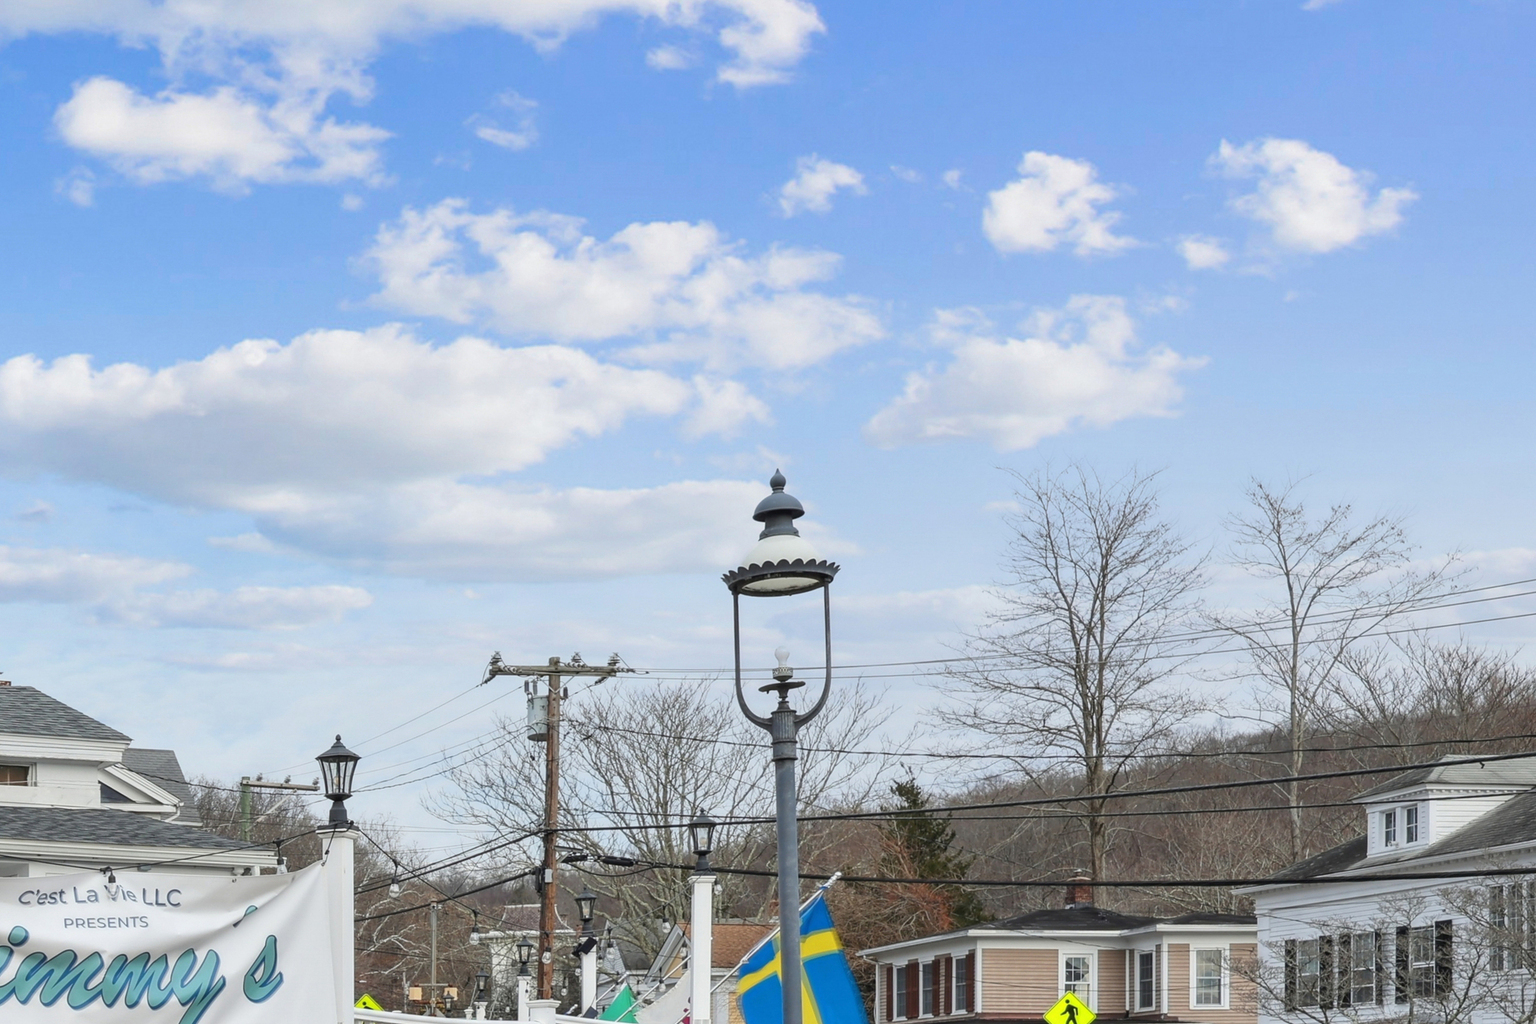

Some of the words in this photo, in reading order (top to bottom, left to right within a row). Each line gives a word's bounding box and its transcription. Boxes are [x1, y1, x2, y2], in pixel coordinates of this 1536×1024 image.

[18, 888, 68, 905] C'est
[73, 886, 99, 904] La
[104, 885, 138, 903] Vie
[142, 888, 182, 907] LLC
[63, 915, 149, 929] PRESENTS
